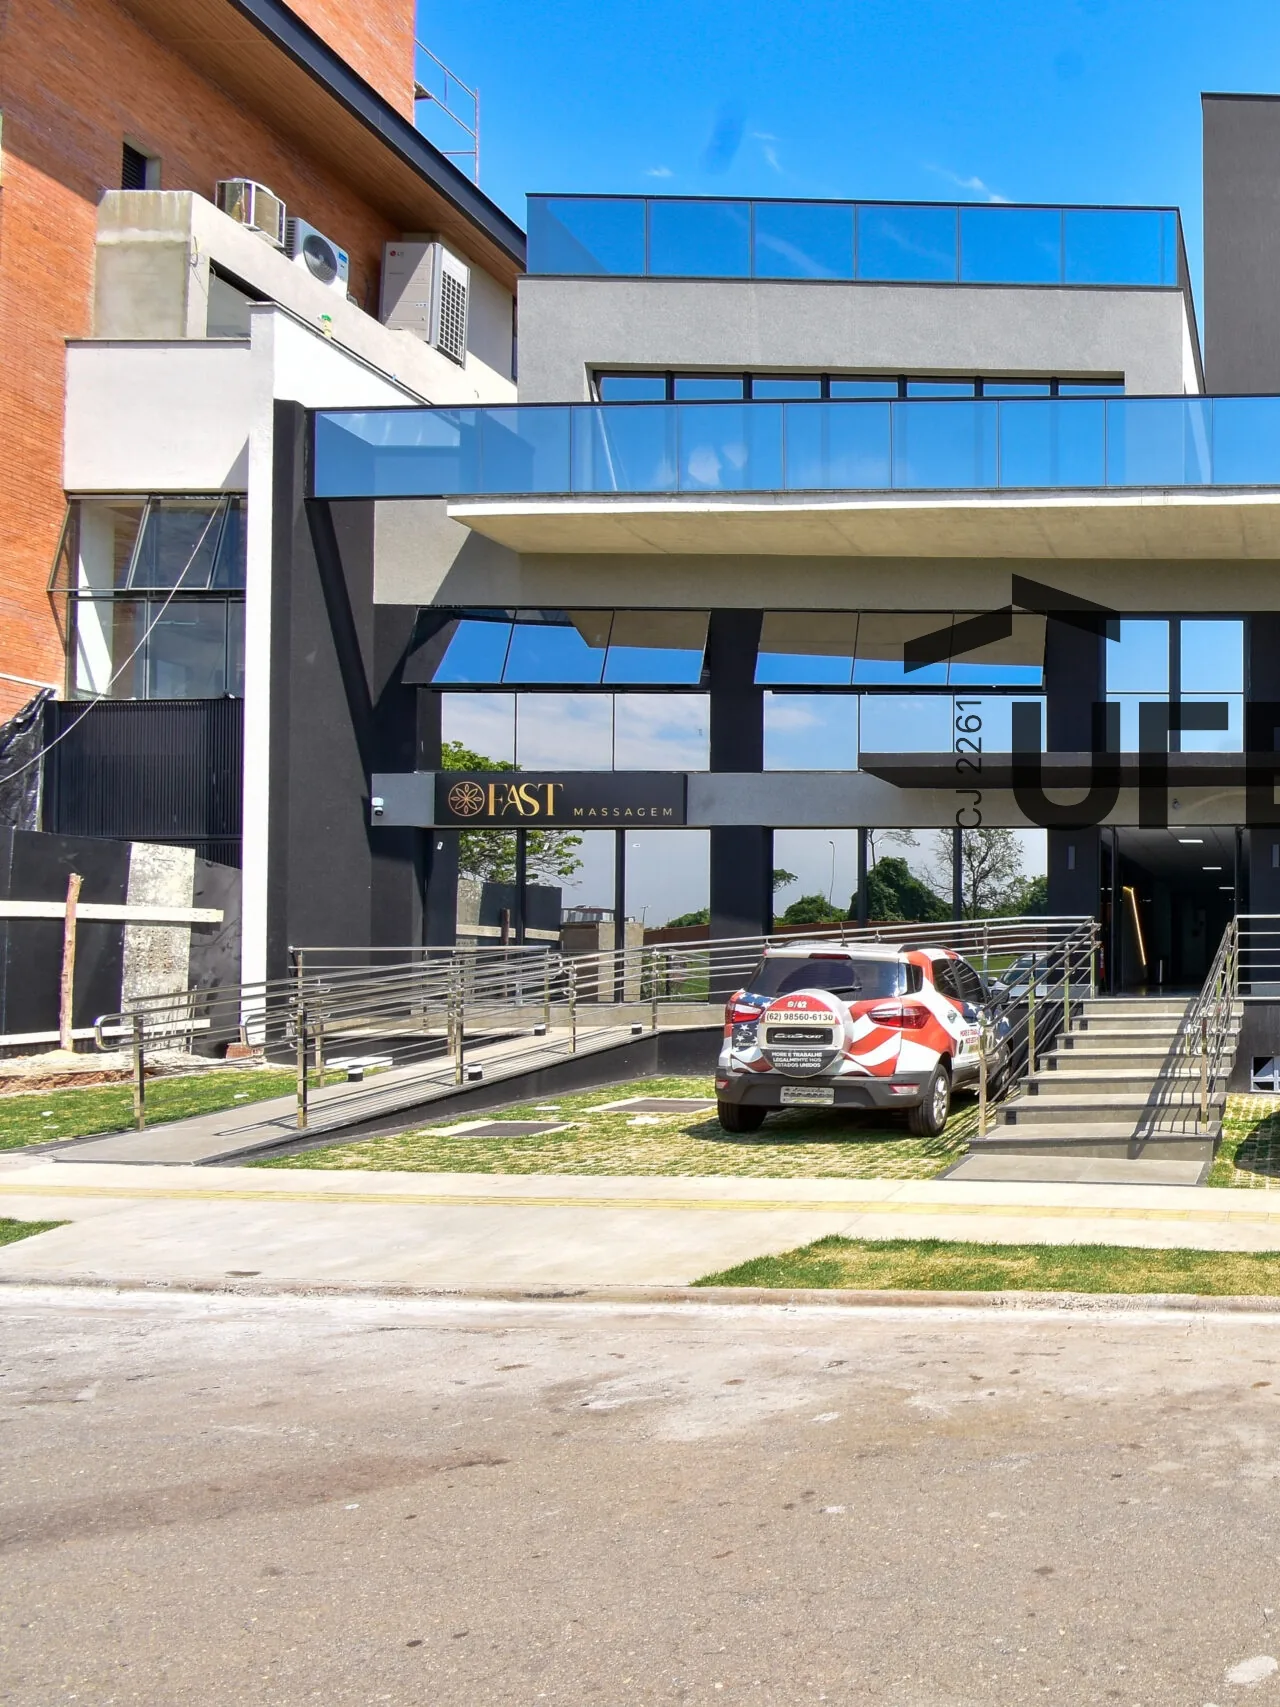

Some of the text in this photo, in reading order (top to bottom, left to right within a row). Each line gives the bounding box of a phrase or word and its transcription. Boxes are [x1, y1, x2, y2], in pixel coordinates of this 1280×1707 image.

[488, 783, 673, 817] FAST MASSAGEM
[766, 1012, 833, 1022] (62) 98560-6130
